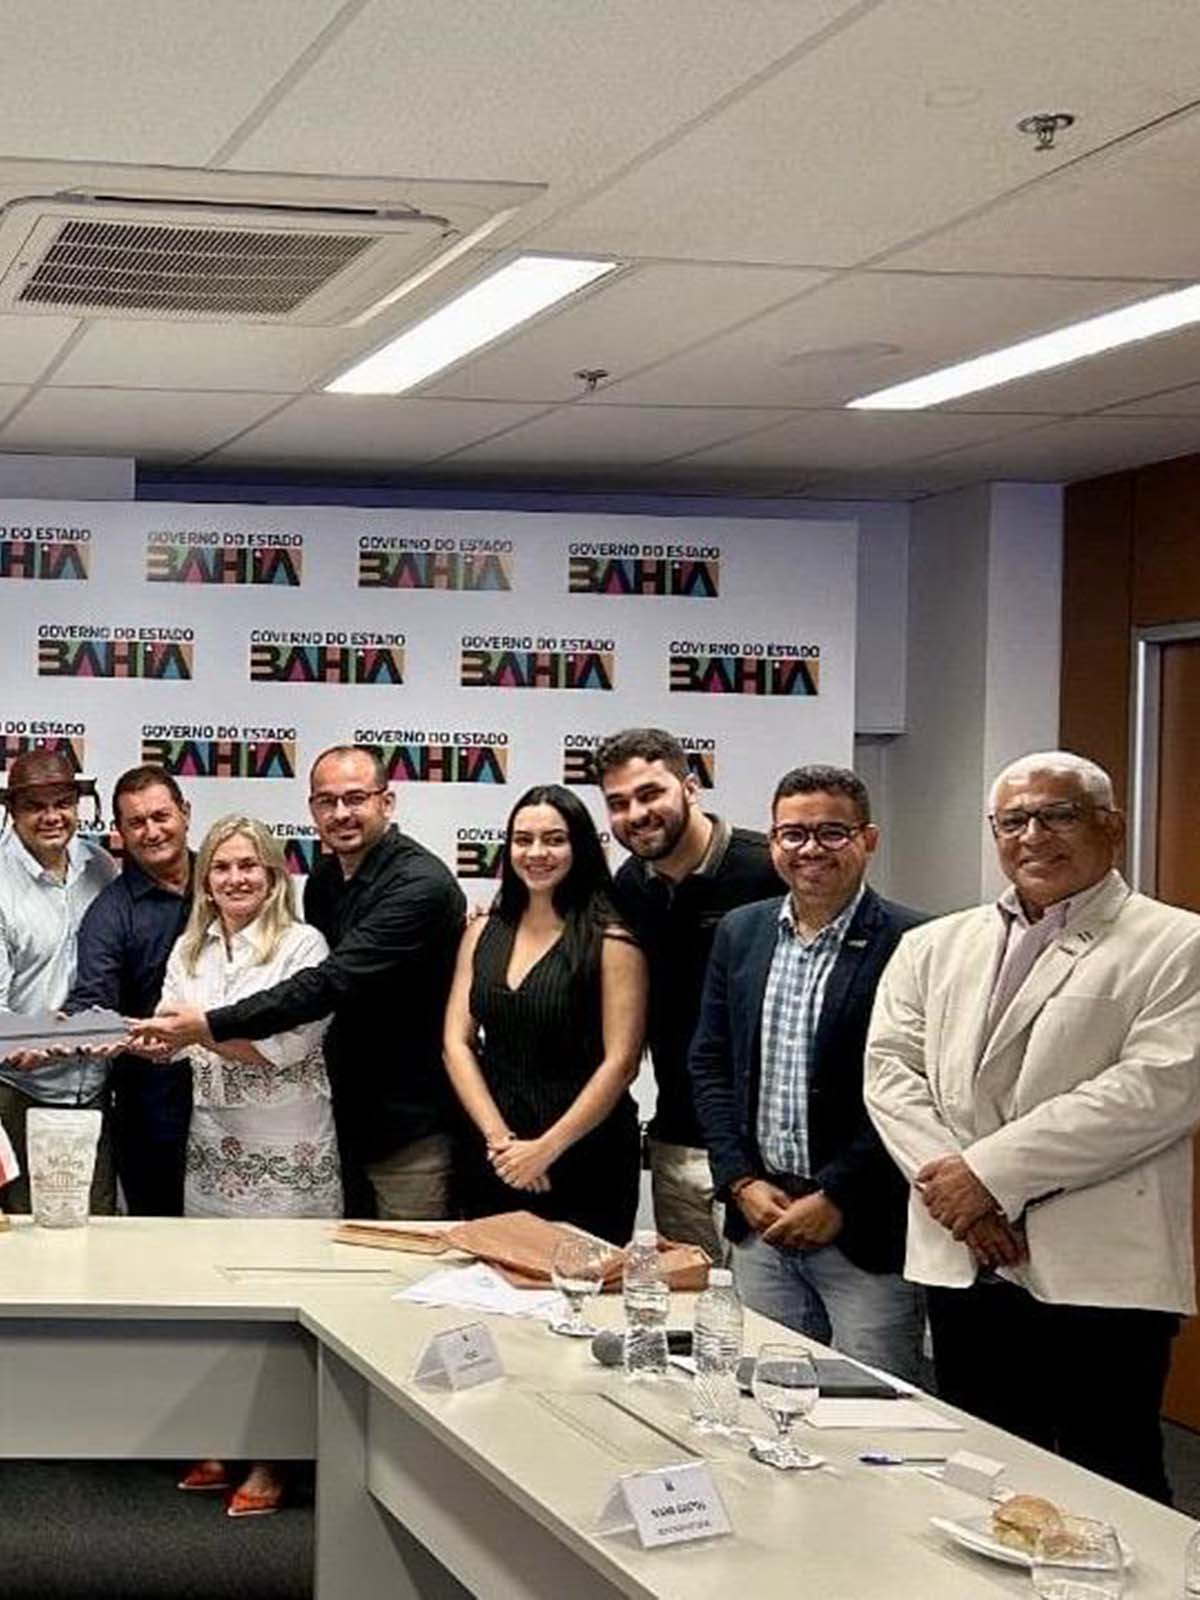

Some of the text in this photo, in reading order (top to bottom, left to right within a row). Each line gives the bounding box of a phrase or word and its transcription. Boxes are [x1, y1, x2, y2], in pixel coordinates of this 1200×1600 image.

[11, 526, 30, 539] DO
[35, 527, 91, 541] ESTADO
[148, 530, 302, 546] GOVERNO DO ESTADO
[359, 536, 512, 552] GOVERNO DO ESTADO
[570, 543, 720, 559] GOVERNO DO ESTADO
[148, 545, 302, 586] BAHIA
[358, 552, 512, 590] BAHIA
[569, 558, 719, 597] BAHIA
[39, 625, 194, 642] GOVERNO DO ESTADO
[251, 631, 405, 646] GOVERNO DO ESTADO
[462, 636, 615, 651] GOVERNO DO ESTADO
[670, 642, 820, 657] GOVERNO DO ESTADO
[38, 641, 193, 680] BAHIA
[250, 646, 404, 684] BAHIA
[462, 651, 614, 690] BAHIA
[669, 657, 819, 696] BAHIA
[5, 721, 25, 734] DO
[30, 722, 85, 736] ESTADO
[142, 724, 296, 741] GOVERNO DO ESTADO
[354, 730, 508, 746] GOVERNO DO ESTADO
[681, 737, 715, 750] TADO
[141, 739, 297, 778] BAHIA
